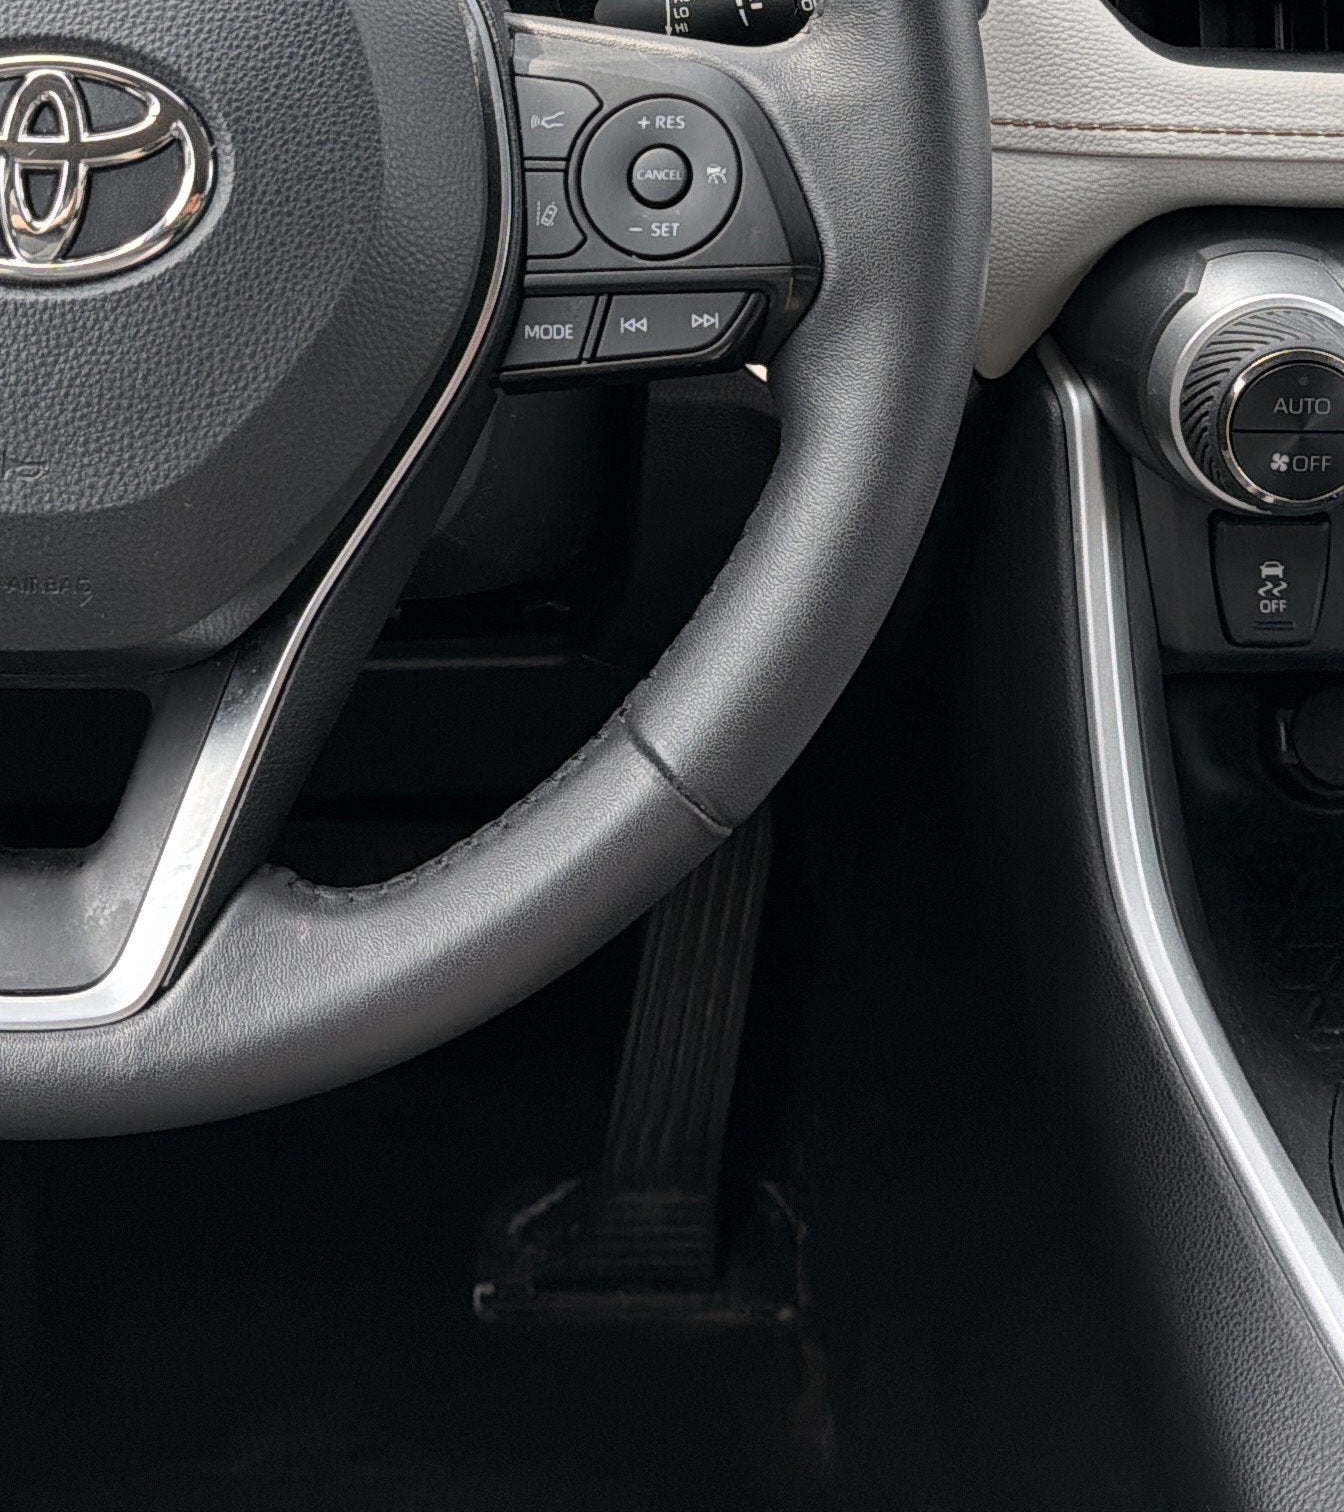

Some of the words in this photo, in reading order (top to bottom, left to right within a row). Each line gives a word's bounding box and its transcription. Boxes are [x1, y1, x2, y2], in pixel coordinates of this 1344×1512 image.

[673, 6, 690, 19] LO
[674, 23, 689, 34] HI
[655, 115, 686, 130] RES
[637, 169, 683, 181] CANCEL
[650, 223, 680, 237] SET
[524, 324, 574, 340] MODE
[1272, 397, 1331, 417] AUTO
[1292, 454, 1333, 473] OFF
[1259, 600, 1288, 614] OFF
